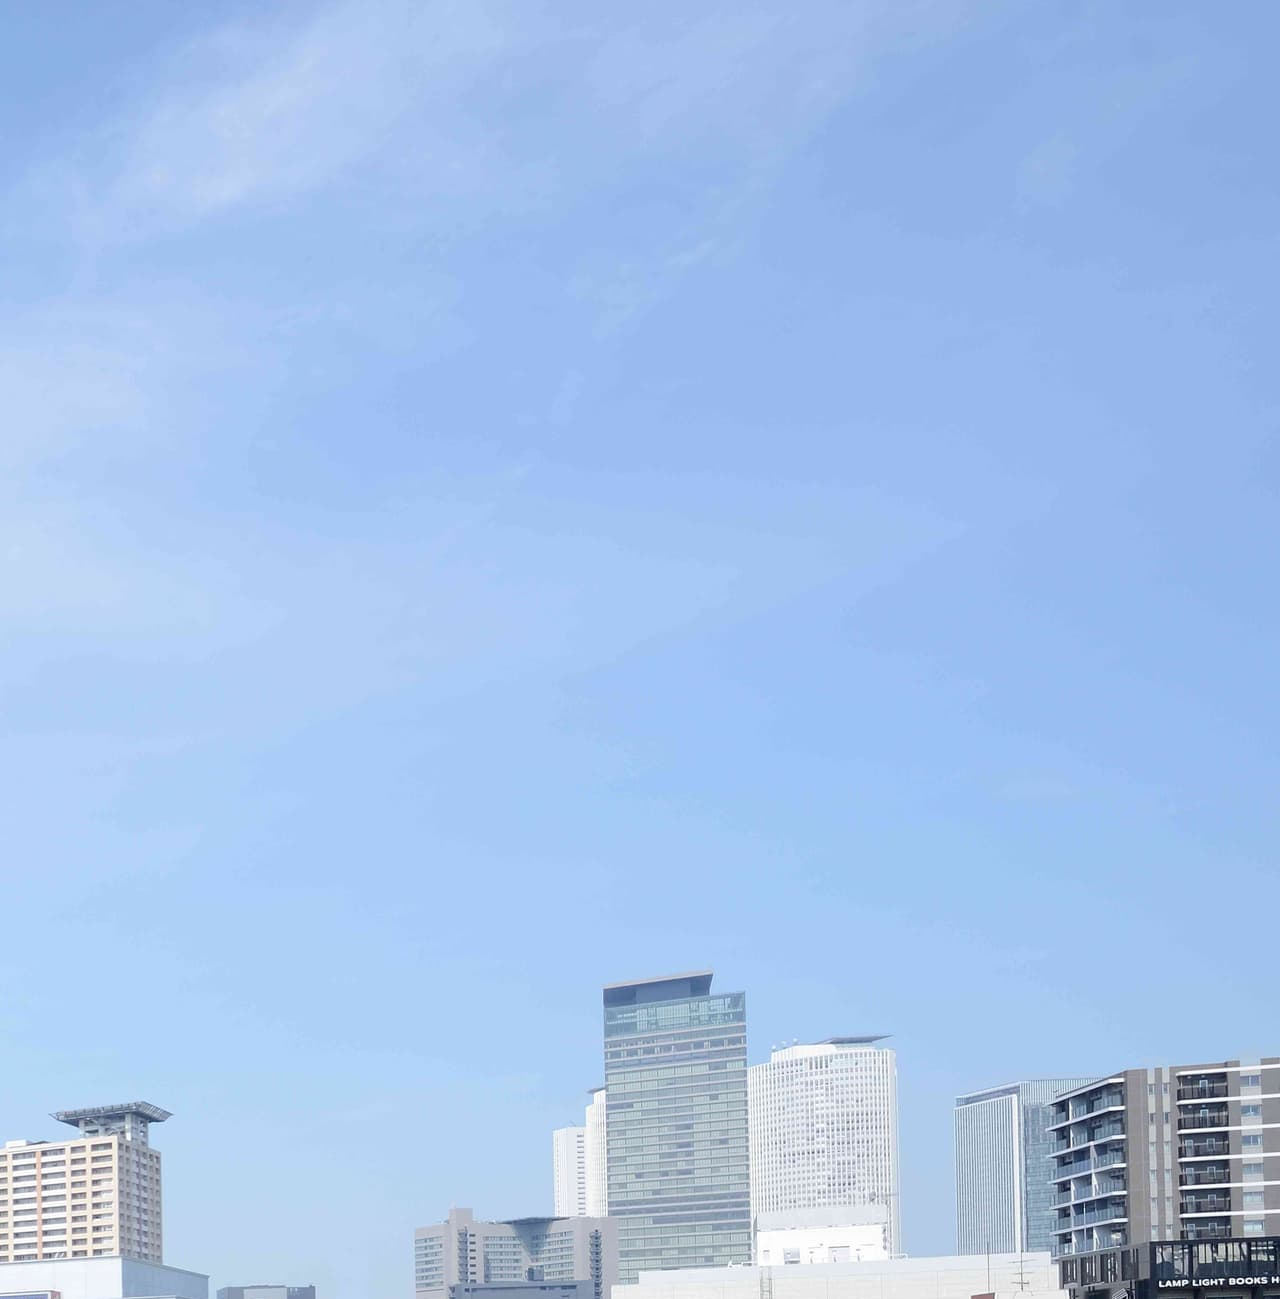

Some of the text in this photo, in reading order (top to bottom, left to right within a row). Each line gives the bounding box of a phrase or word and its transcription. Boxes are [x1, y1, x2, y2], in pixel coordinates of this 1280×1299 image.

[1158, 1279, 1189, 1288] LAMP
[1192, 1278, 1225, 1287] LIGHT
[1228, 1276, 1268, 1286] BOOKS
